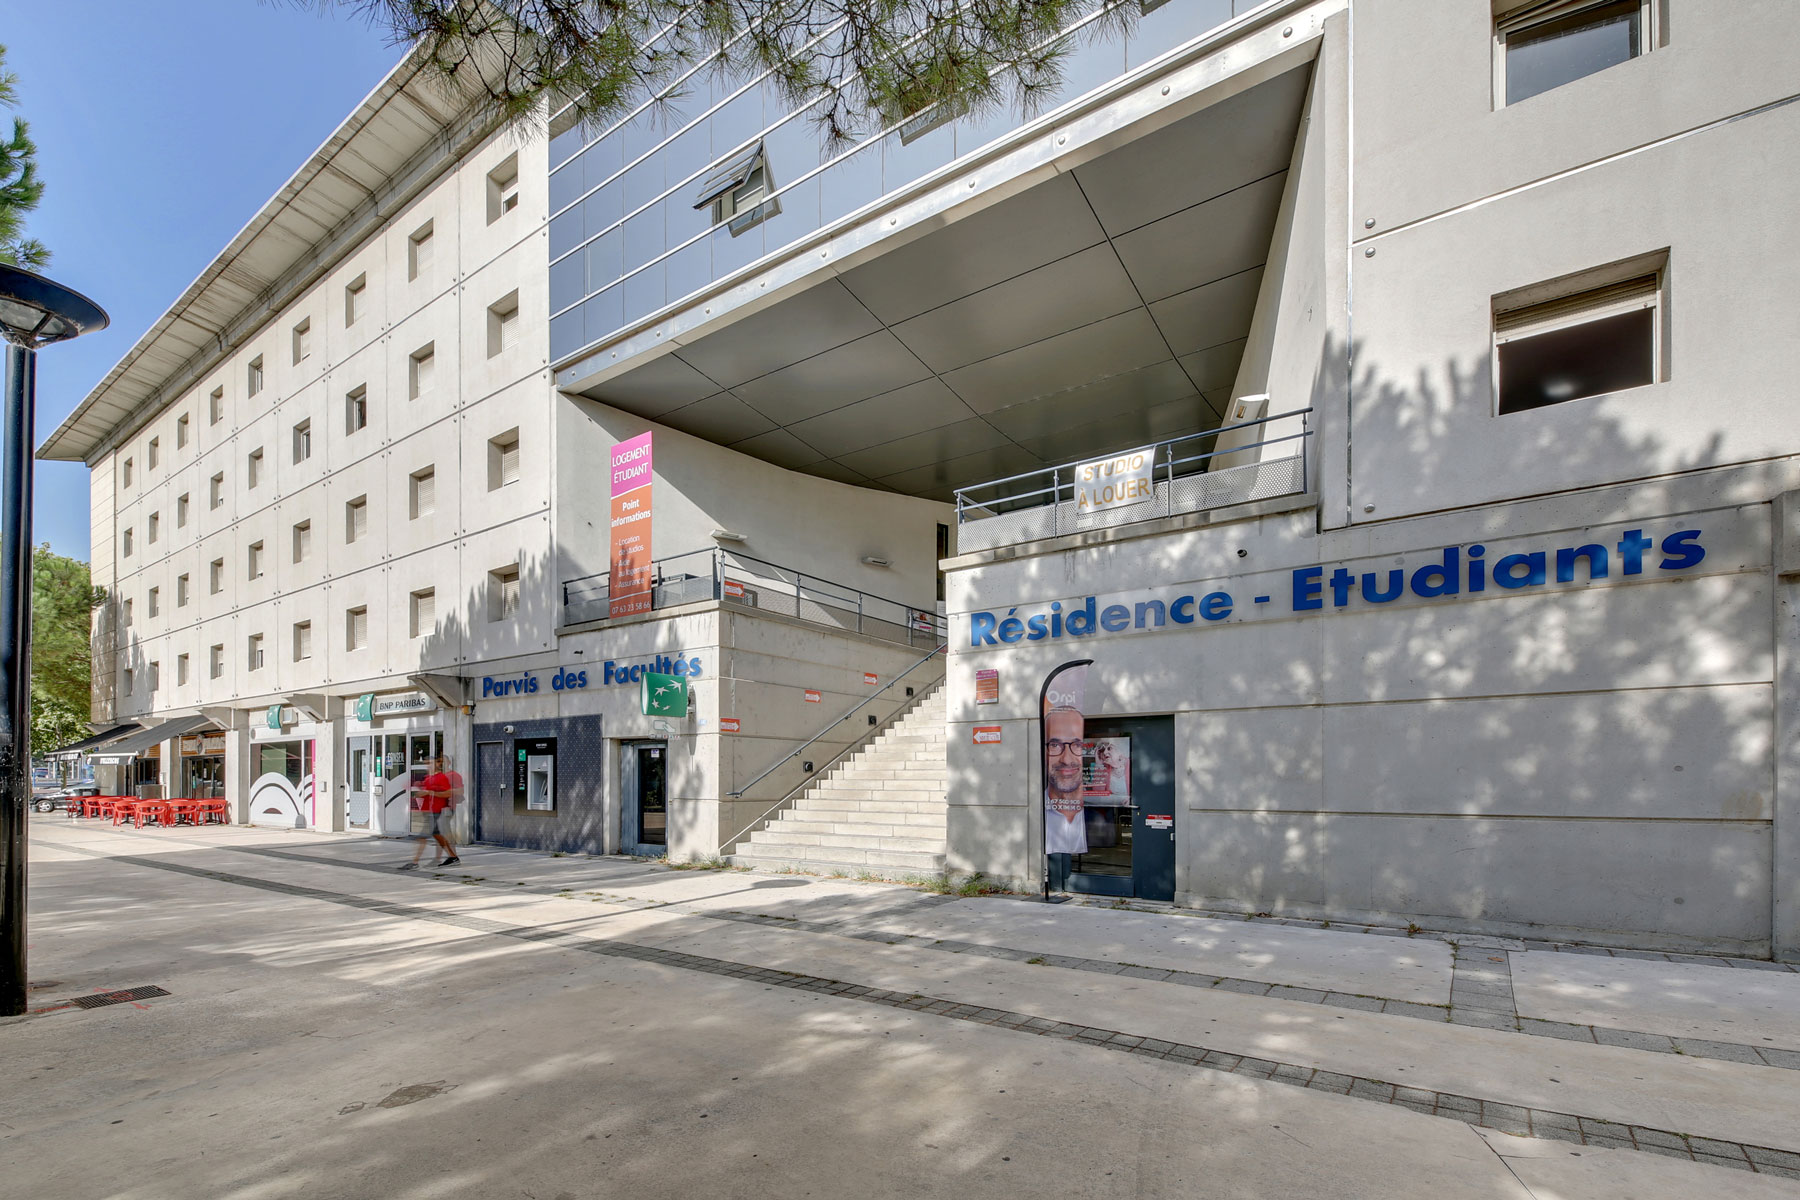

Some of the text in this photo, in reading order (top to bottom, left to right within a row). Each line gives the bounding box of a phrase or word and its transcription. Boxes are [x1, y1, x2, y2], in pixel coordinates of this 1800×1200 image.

[612, 444, 651, 467] LOGEMENT
[613, 462, 649, 484] ÉTUDIANT
[1083, 455, 1144, 482] STUDIO
[1078, 477, 1150, 509] À LOUER
[622, 498, 640, 512] Point
[611, 510, 651, 528] informations
[619, 534, 641, 546] Location
[626, 544, 645, 554] studios
[625, 564, 650, 577] logement
[618, 577, 645, 588] Assurance
[971, 591, 1234, 647] Résidence
[1292, 528, 1706, 612] Etudiants
[612, 600, 651, 614] 07 63 23 58 66
[482, 671, 539, 698] Parvis
[552, 666, 588, 691] des
[379, 697, 426, 710] BNP PARIBAS
[1046, 690, 1076, 706] Orpi
